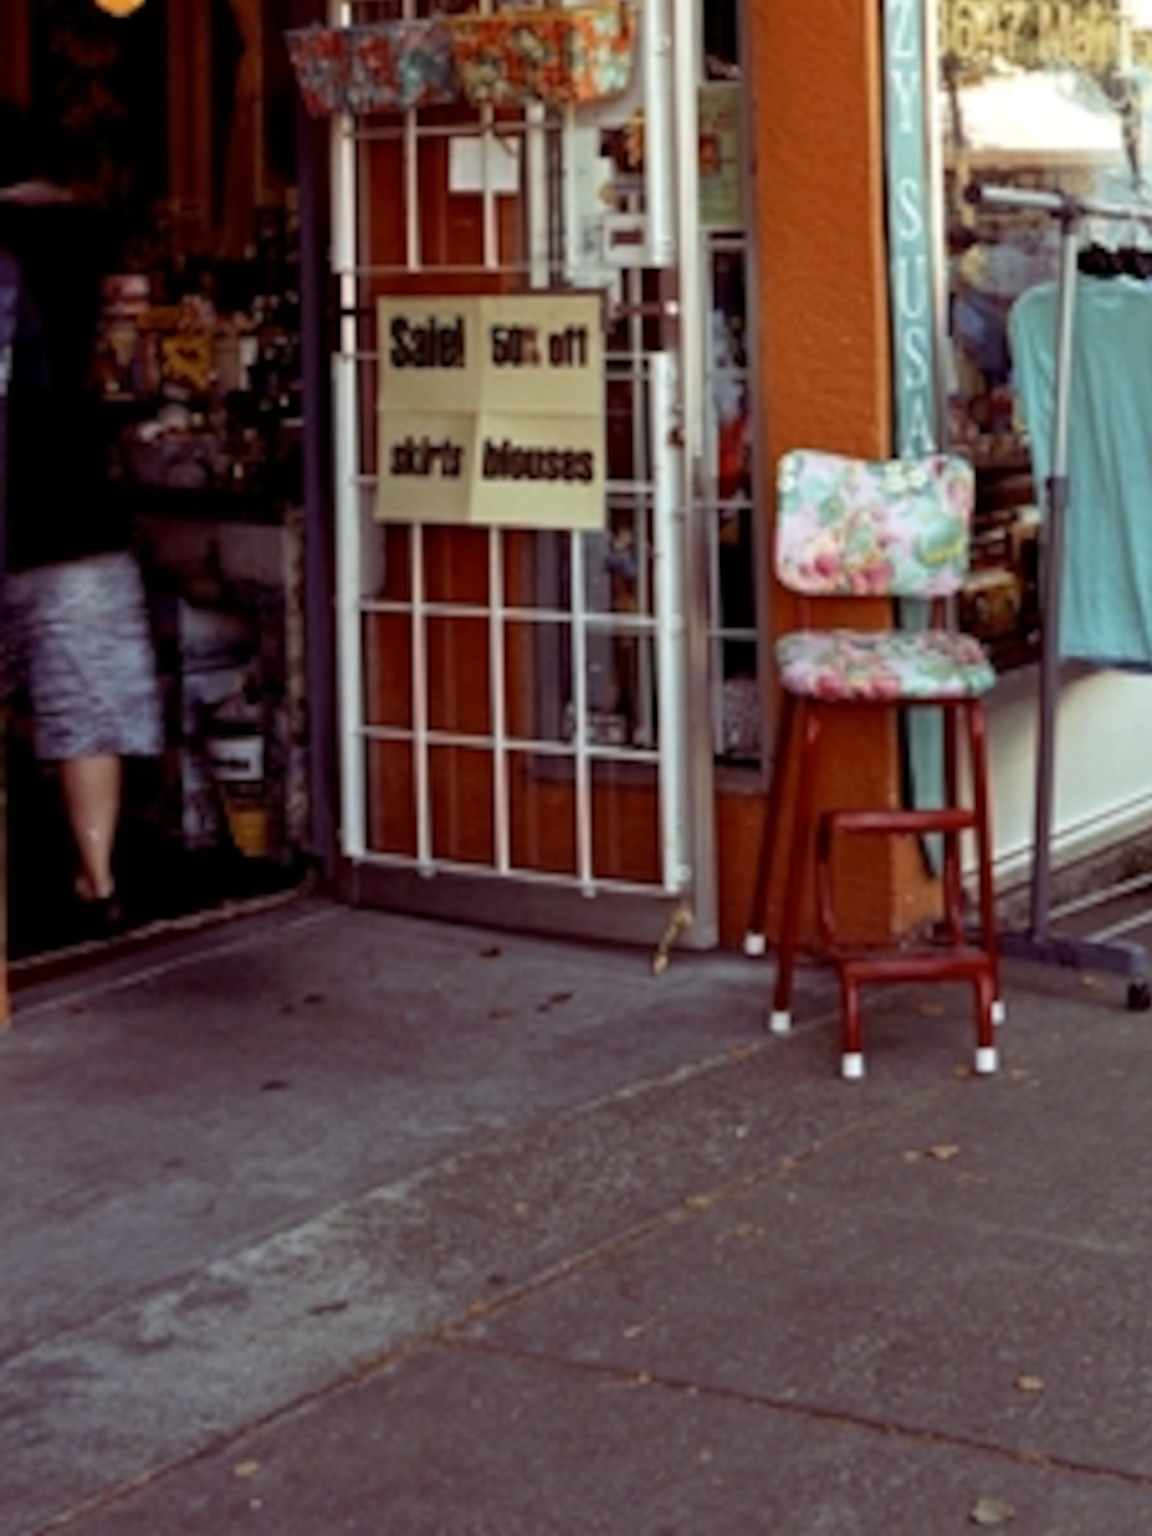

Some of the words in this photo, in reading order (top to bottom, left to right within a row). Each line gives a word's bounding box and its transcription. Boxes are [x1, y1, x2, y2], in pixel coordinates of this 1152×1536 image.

[390, 315, 467, 369] Sale!
[492, 325, 543, 368] 50%
[549, 325, 588, 367] off
[898, 176, 936, 459] SUSA
[391, 433, 463, 476] skirts
[481, 437, 594, 484] blouses
